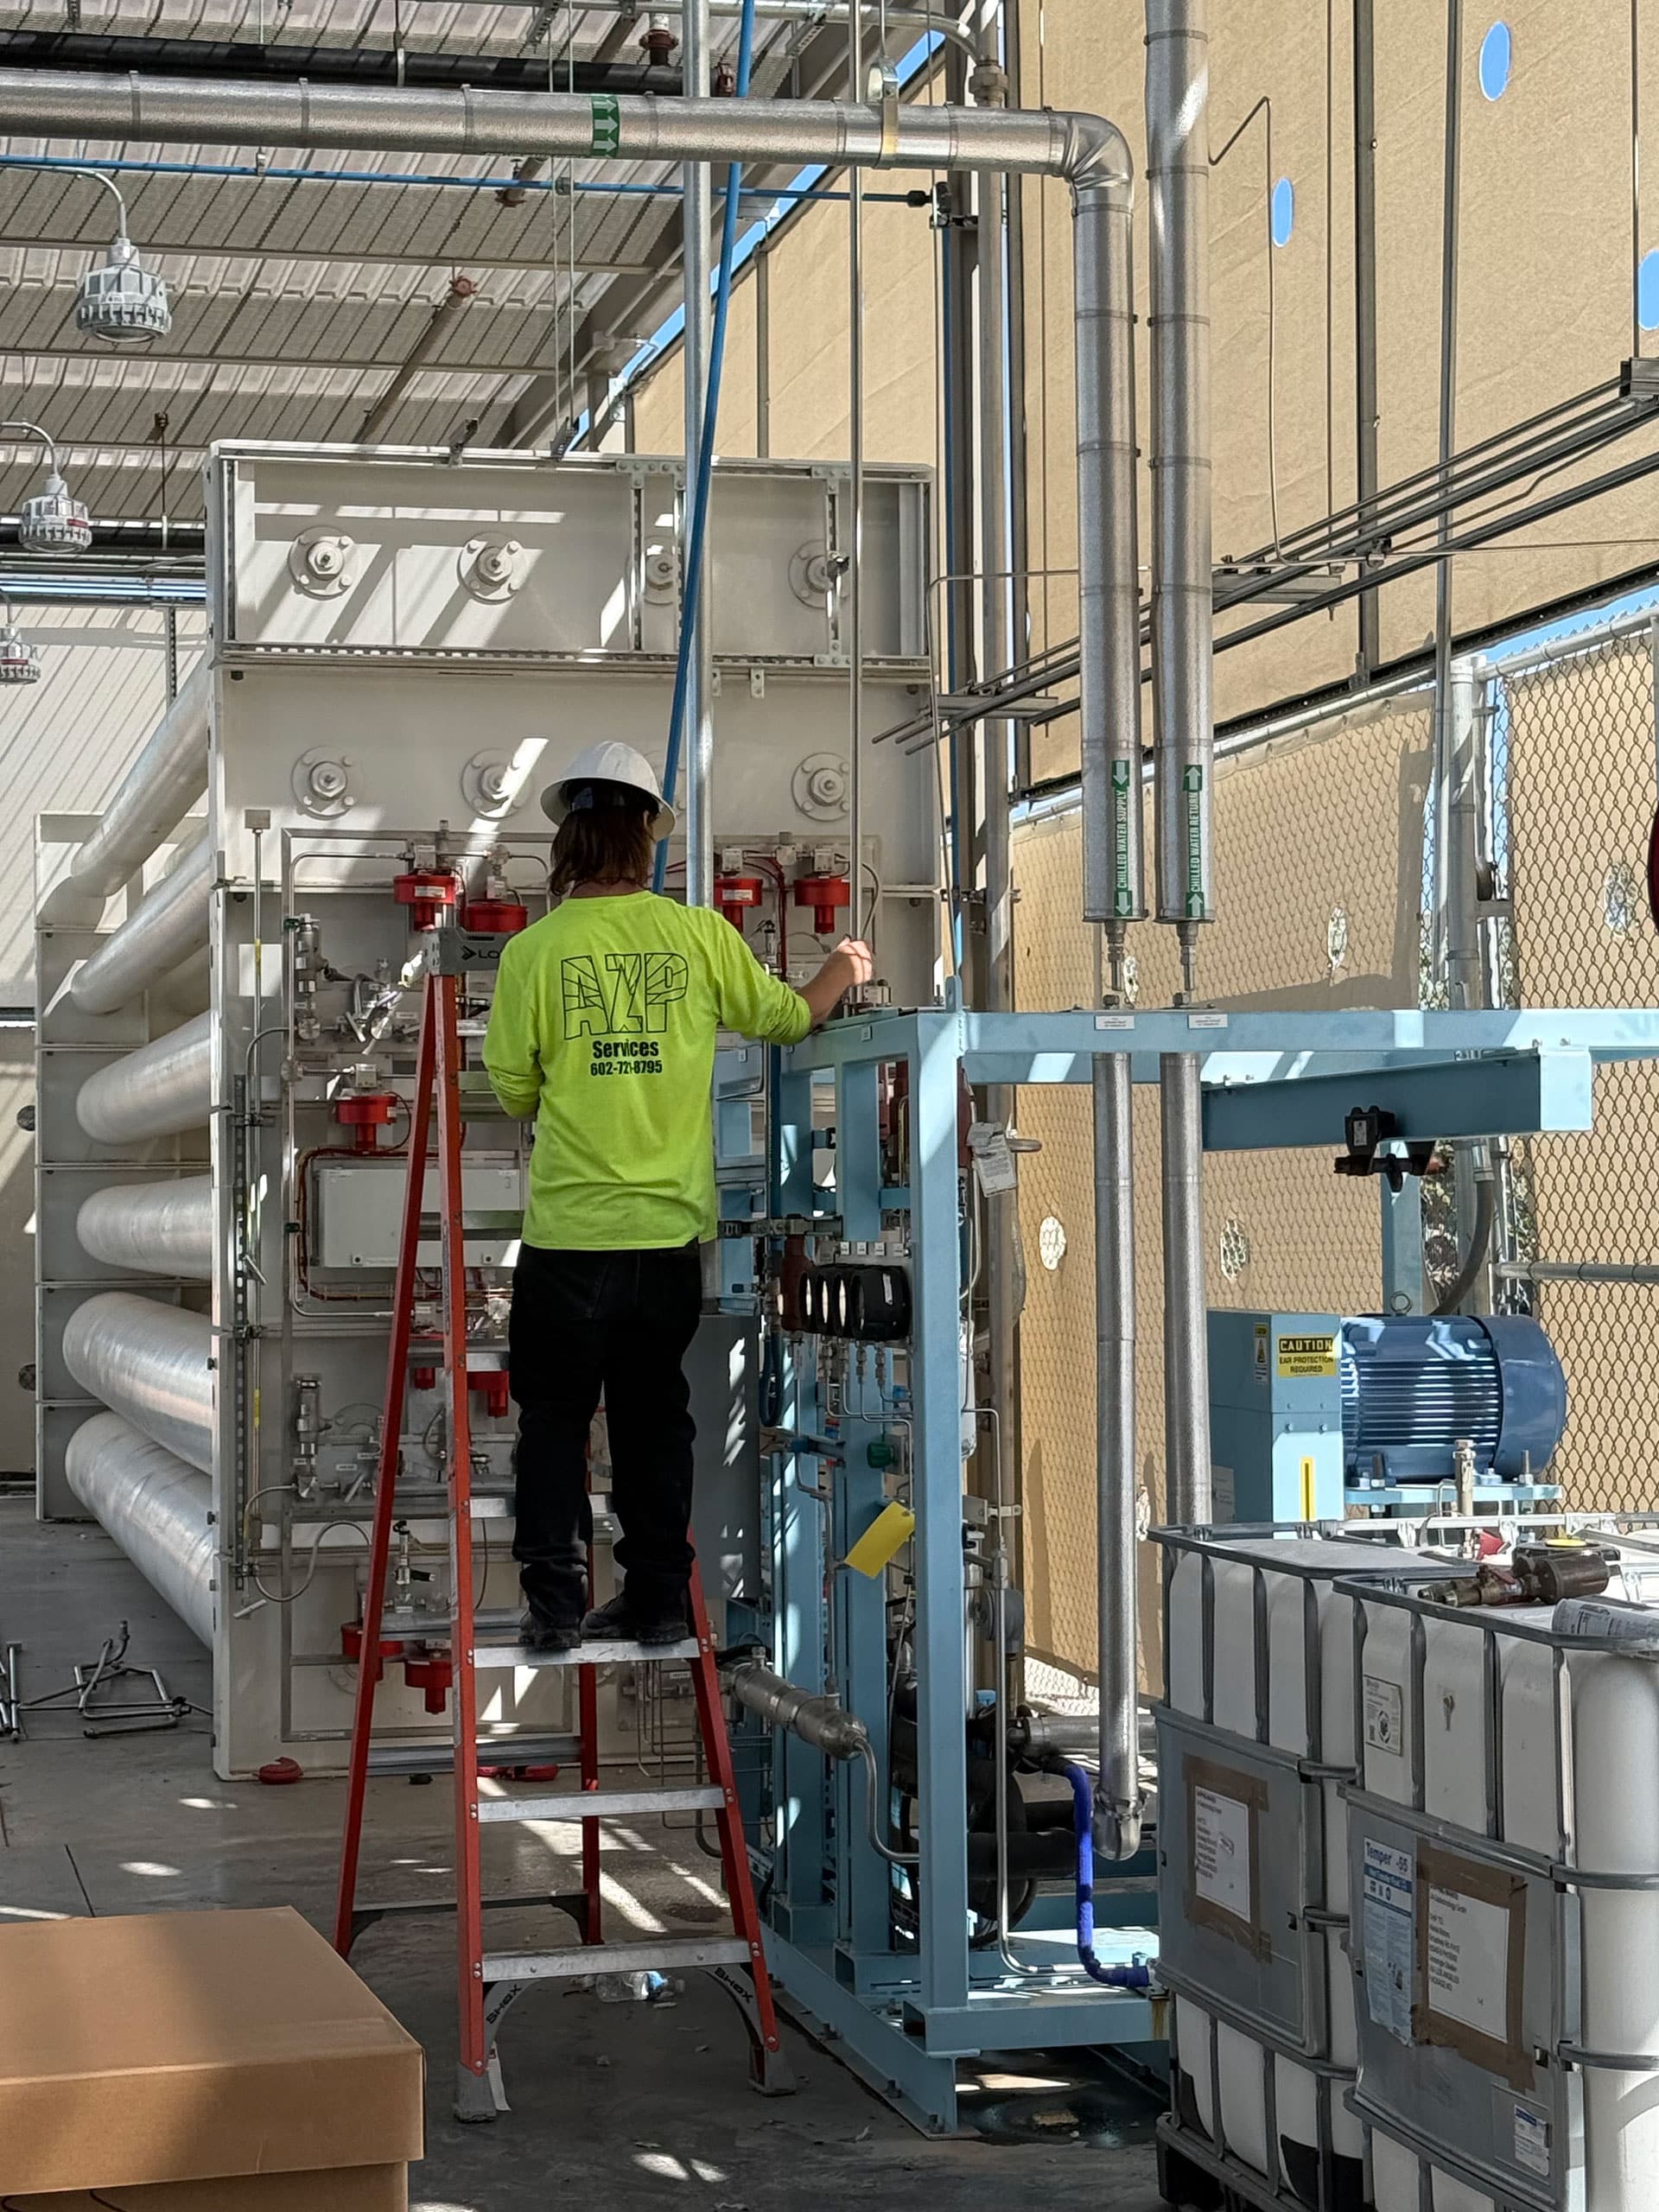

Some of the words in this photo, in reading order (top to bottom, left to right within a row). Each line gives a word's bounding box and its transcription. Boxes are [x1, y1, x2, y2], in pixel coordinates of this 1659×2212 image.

[1116, 790, 1127, 822] SUPPLY
[1188, 791, 1199, 826] RETURN
[1116, 823, 1128, 852] WATER
[1189, 827, 1200, 856] WATER
[1116, 854, 1128, 889] CHILLED
[1191, 857, 1201, 893] CHILLED
[592, 1039, 659, 1059] Services
[1281, 1340, 1332, 1351] CAUTION
[1293, 1355, 1333, 1364] PROTECTION
[1290, 1365, 1323, 1374] REQUIRED
[486, 1984, 522, 2024] SHOX
